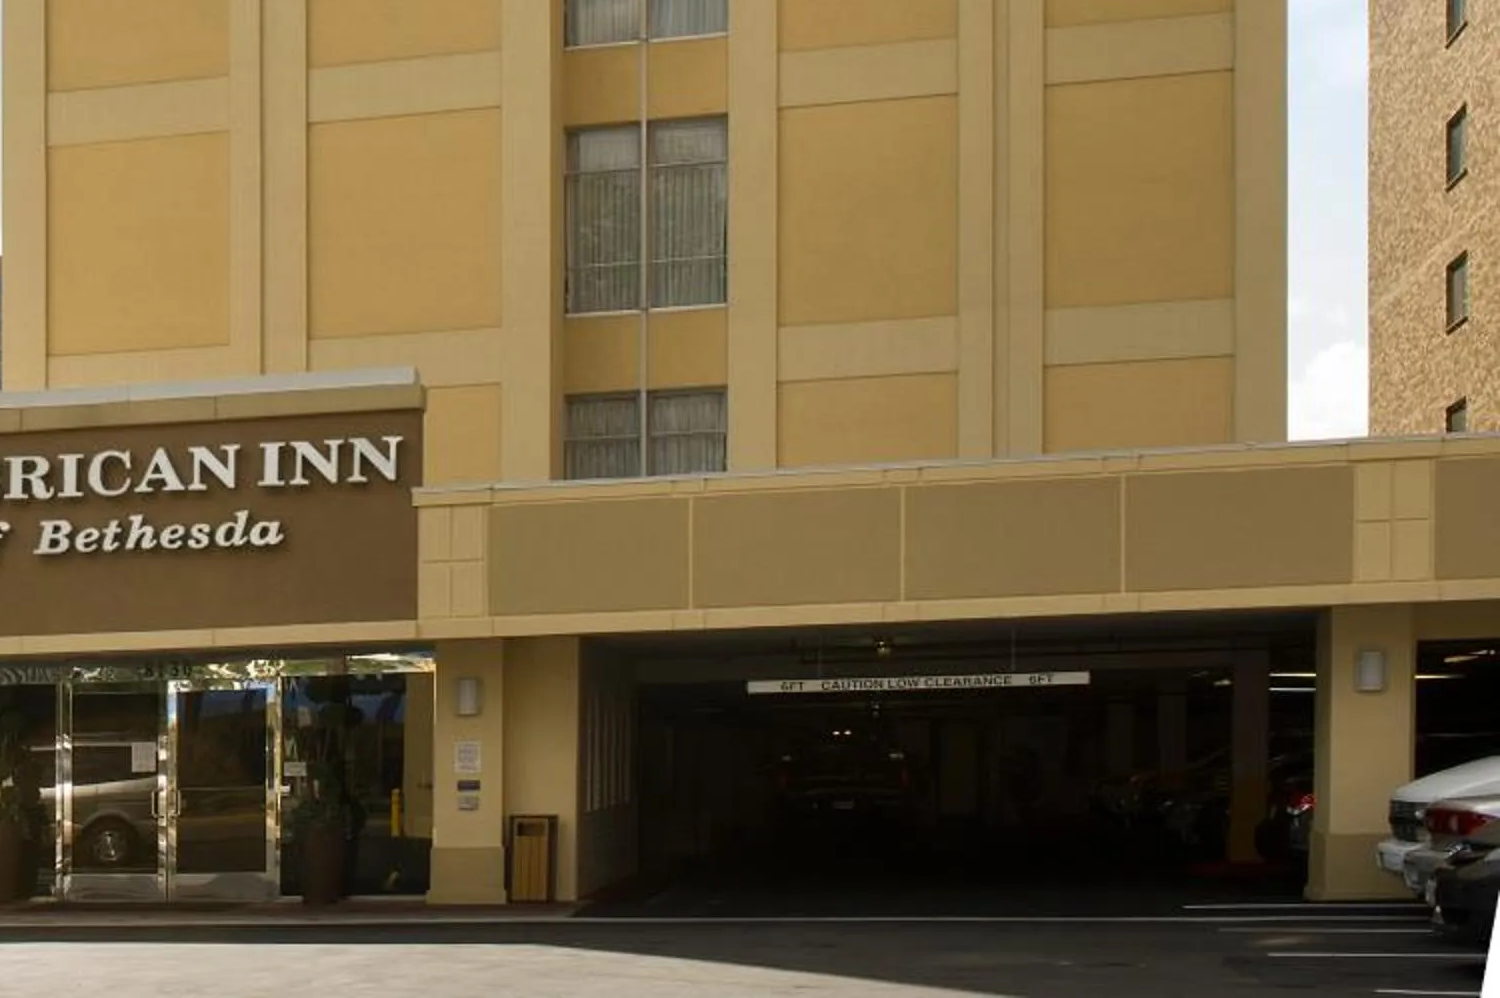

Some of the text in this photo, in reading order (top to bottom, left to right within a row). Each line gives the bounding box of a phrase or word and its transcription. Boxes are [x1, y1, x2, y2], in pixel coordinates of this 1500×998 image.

[257, 435, 404, 487] INN
[32, 509, 284, 556] Bethesda
[780, 680, 804, 691] 6FT
[820, 678, 884, 691] CAUTION
[887, 677, 920, 689] LOW
[924, 675, 1013, 688] CLEARANCE
